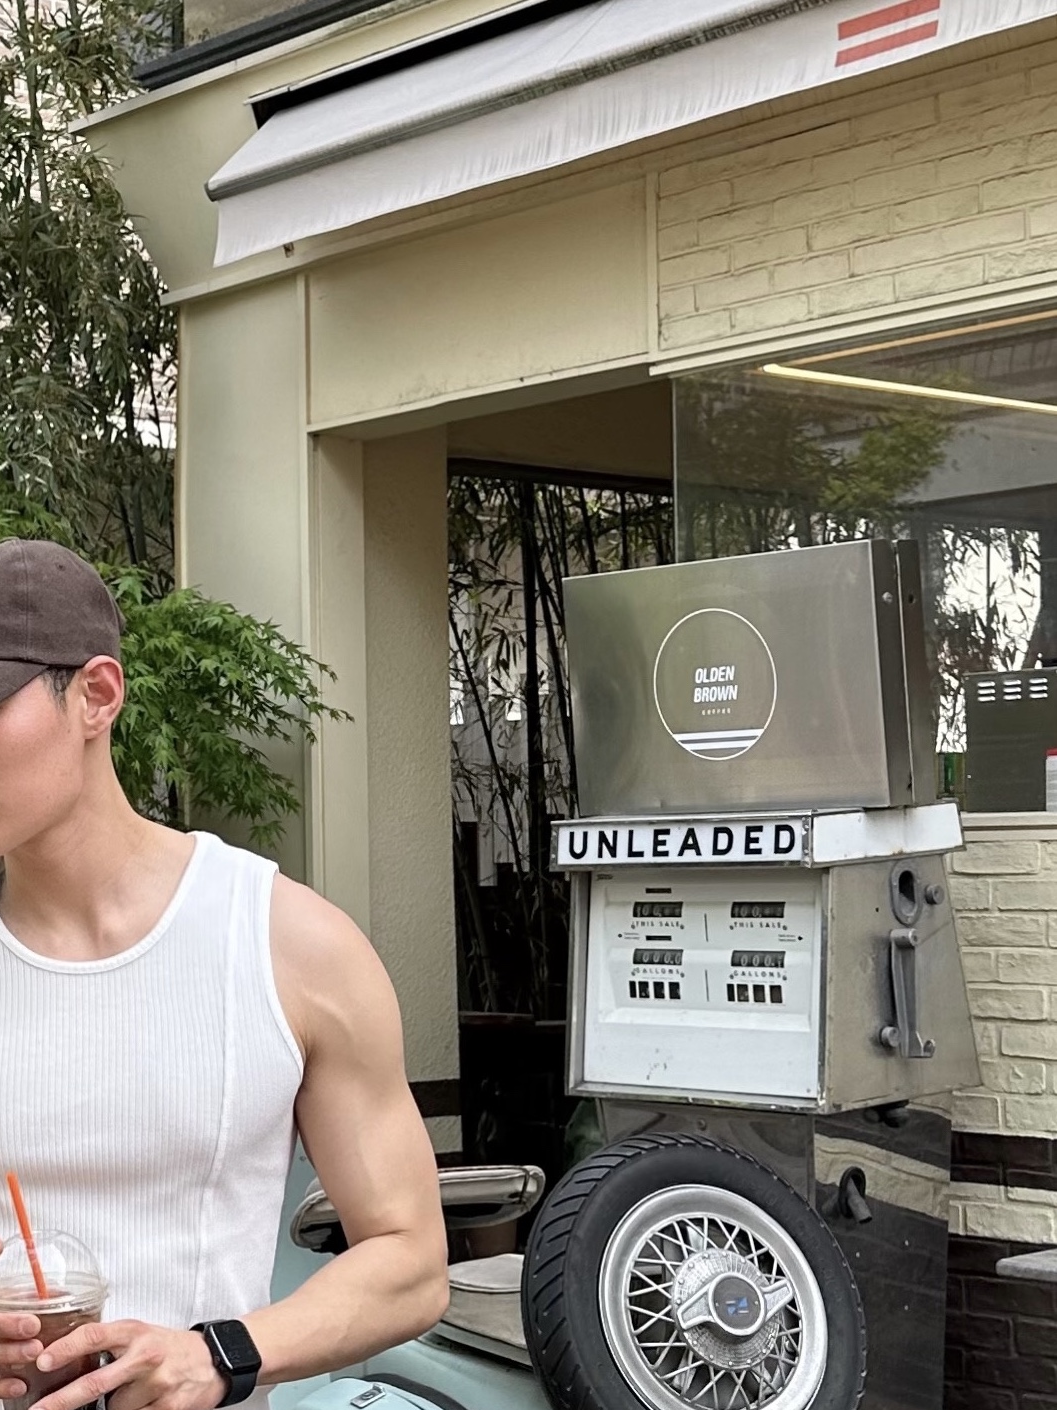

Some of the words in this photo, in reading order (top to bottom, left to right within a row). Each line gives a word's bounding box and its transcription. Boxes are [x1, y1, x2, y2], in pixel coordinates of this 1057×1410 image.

[695, 665, 735, 684] OLDEN
[693, 684, 738, 703] BROWN
[568, 824, 796, 860] UNLEADED
[634, 967, 680, 975] GALLONS
[733, 970, 782, 978] GALLONS
